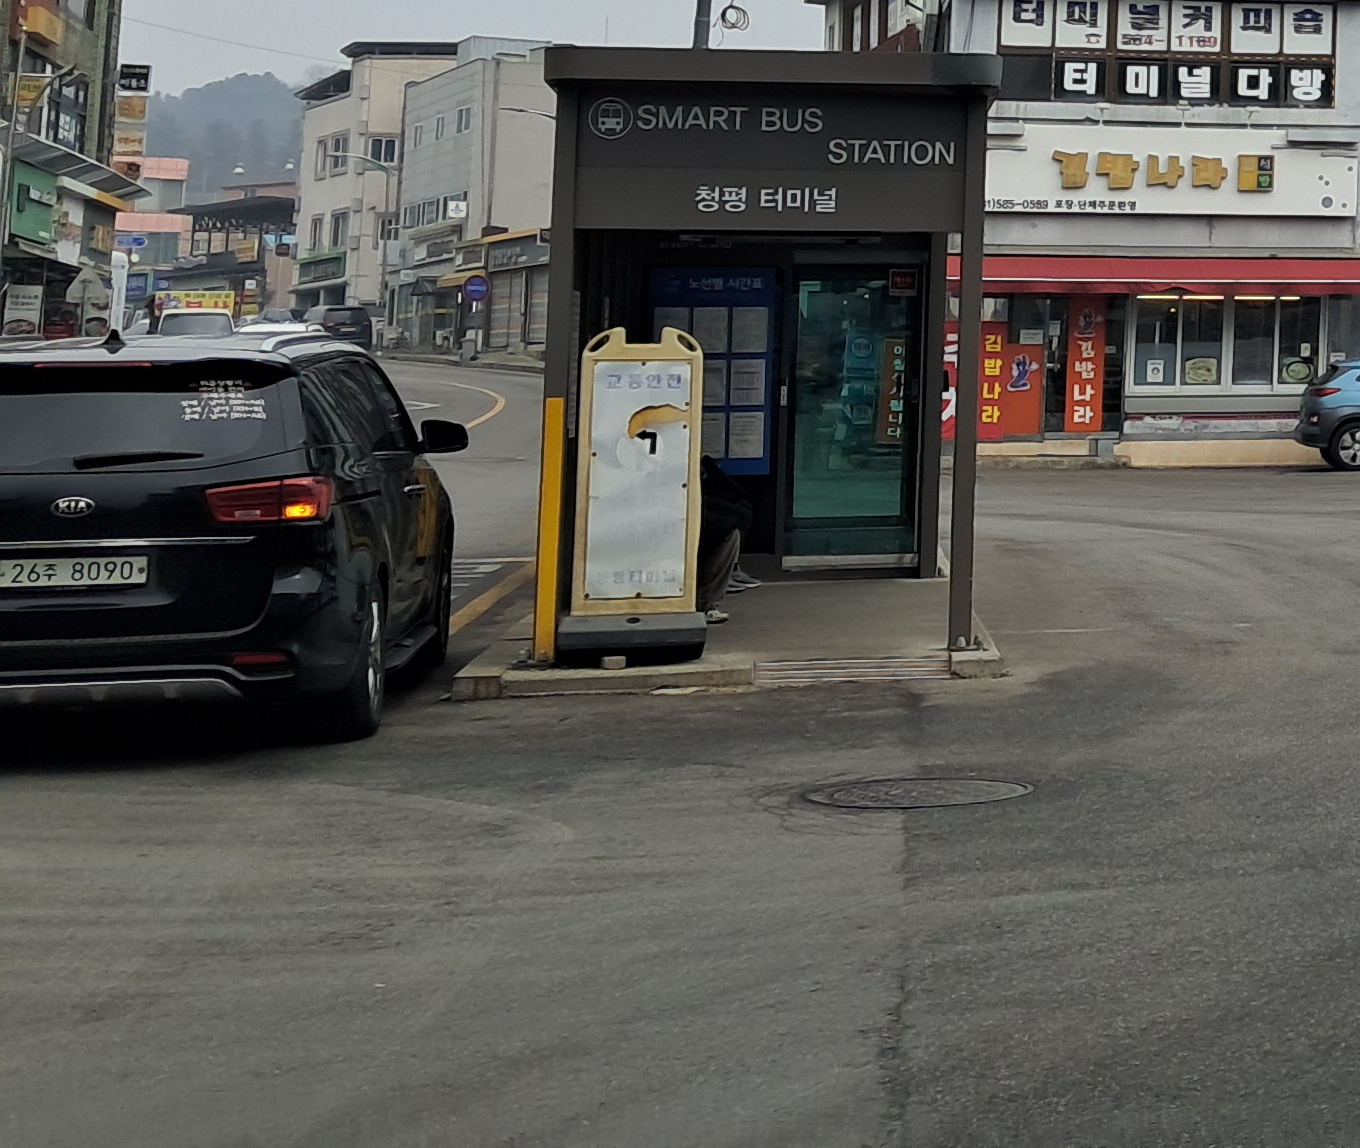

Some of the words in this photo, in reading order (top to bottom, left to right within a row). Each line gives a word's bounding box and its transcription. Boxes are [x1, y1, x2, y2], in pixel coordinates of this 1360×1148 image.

[1062, 61, 1326, 102] 터미널다방
[635, 104, 749, 132] SMART
[759, 106, 824, 133] BUS
[827, 138, 956, 166] STATION
[694, 186, 747, 212] 청평
[759, 186, 838, 213] 터미널
[981, 333, 1004, 424] 김밥나라
[1073, 340, 1097, 424] 김밥나라
[58, 501, 88, 513] KIA
[10, 562, 58, 584] 26주
[70, 560, 134, 582] 8090
